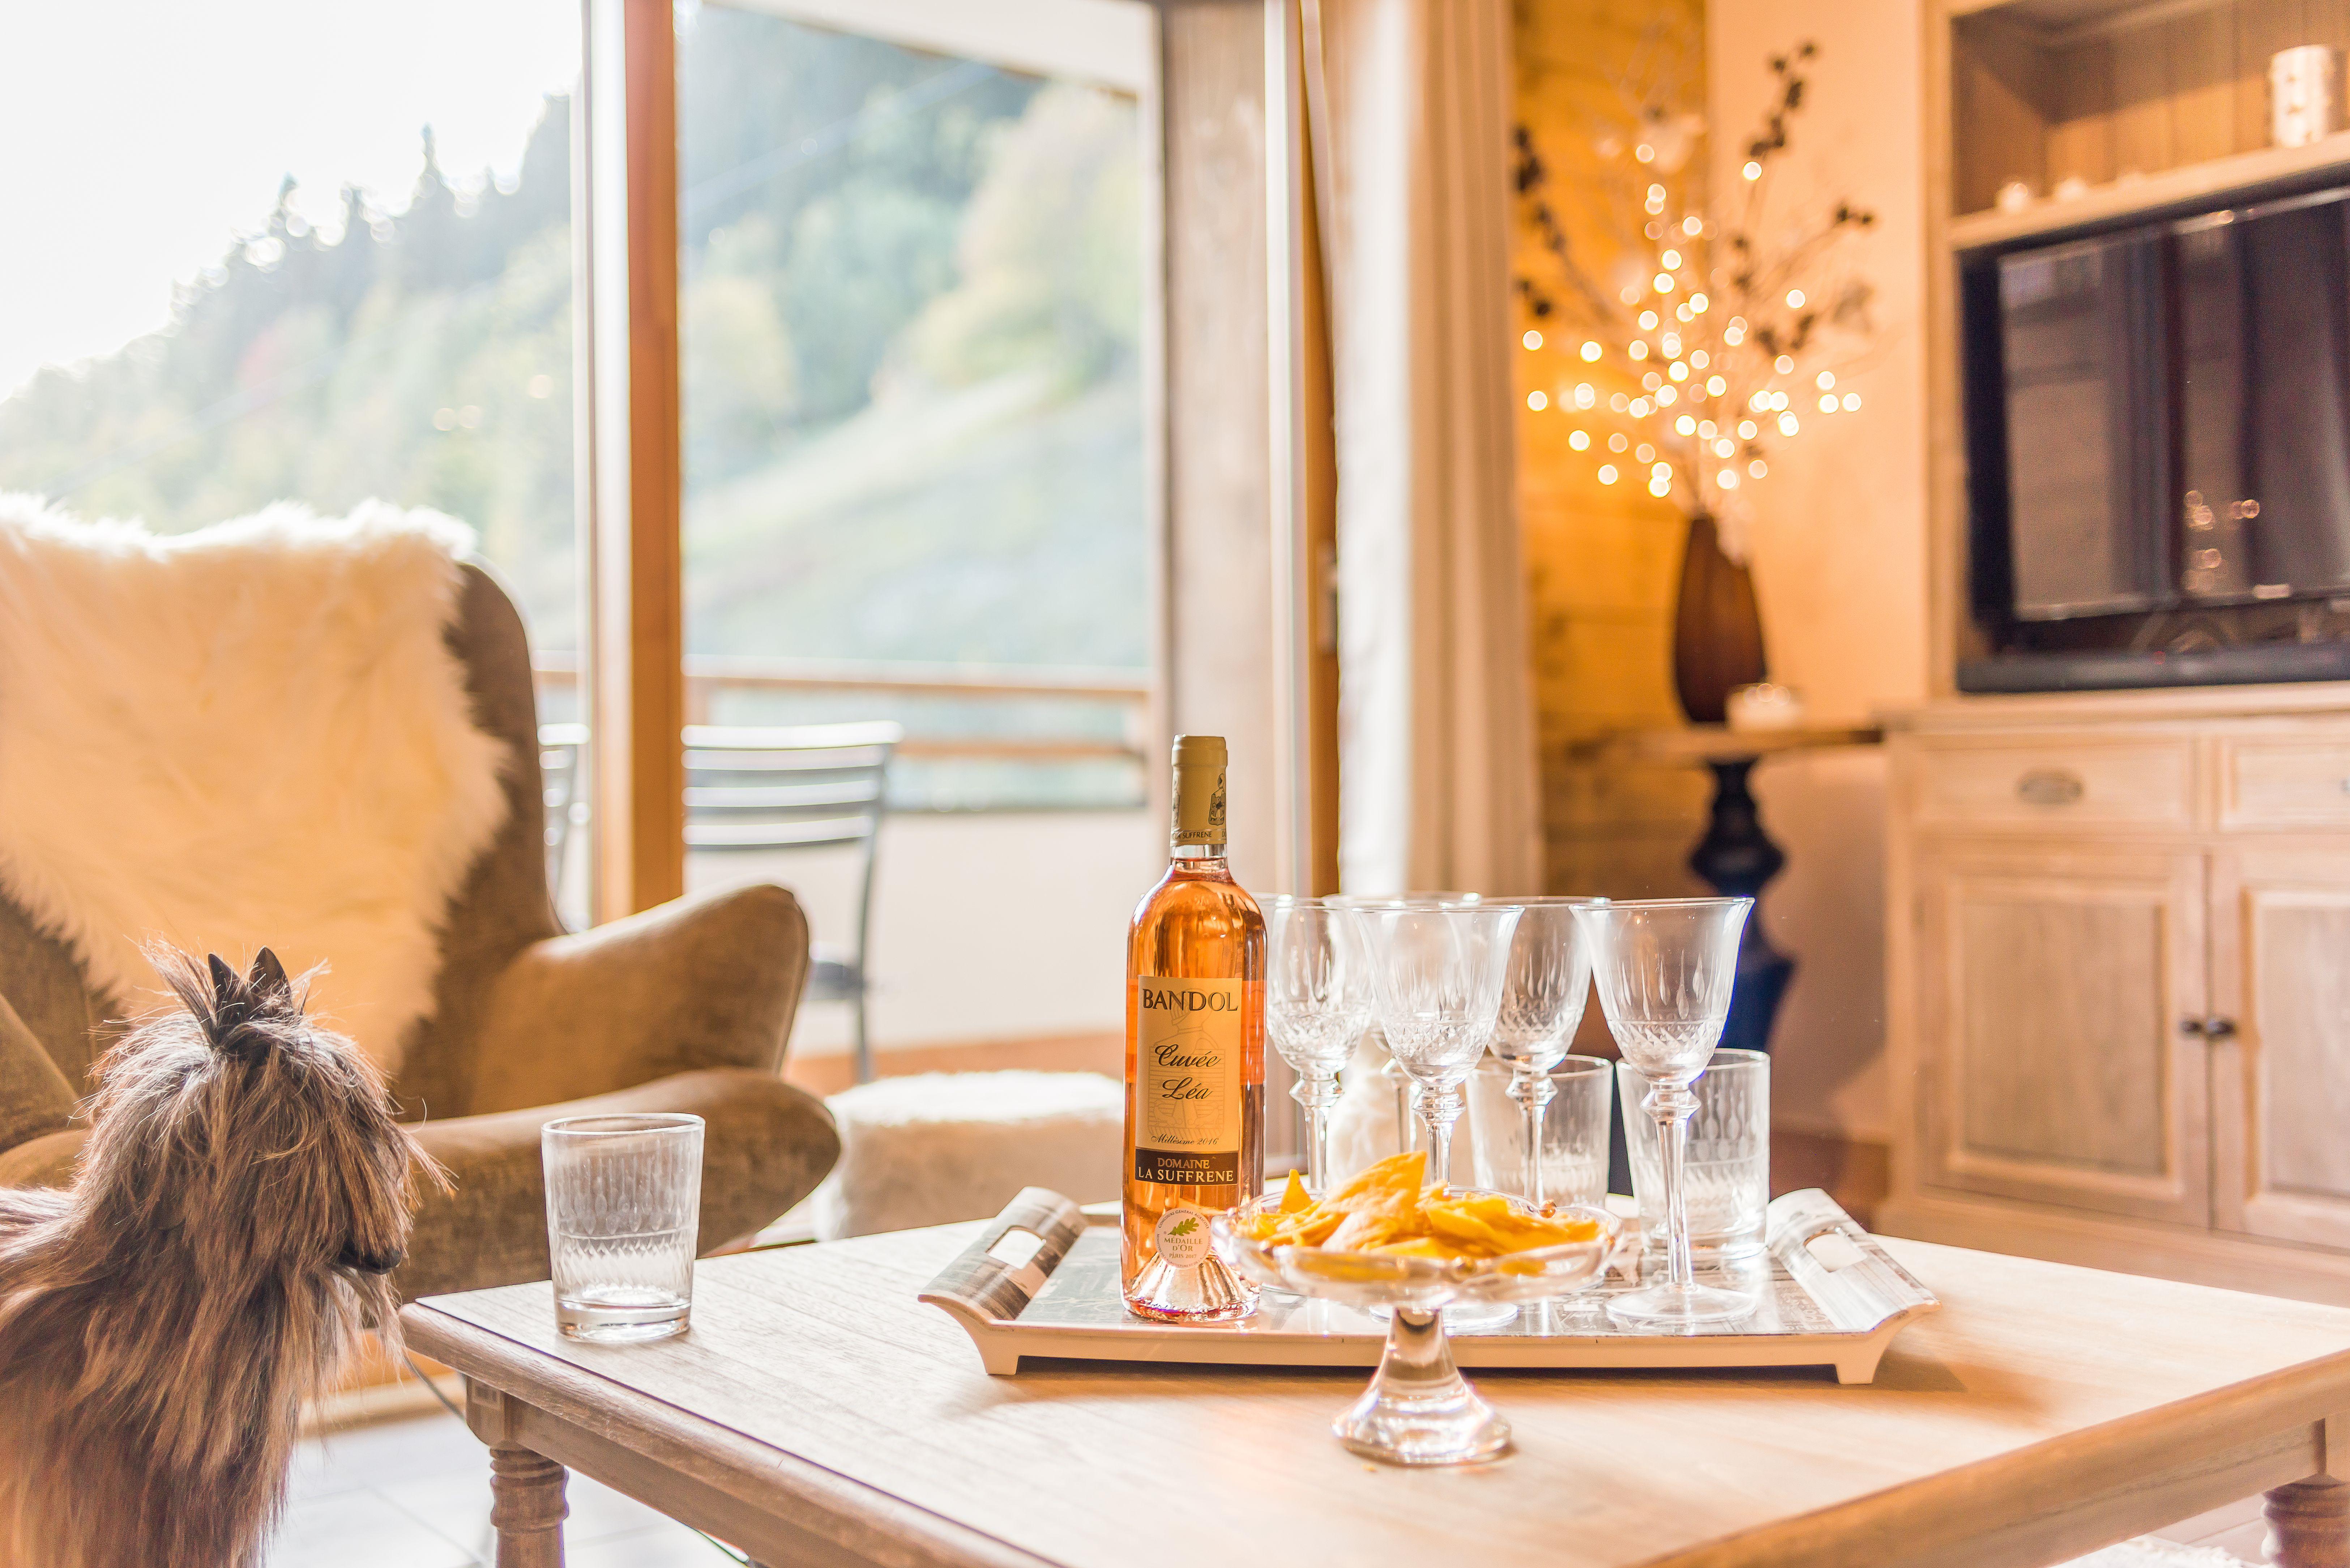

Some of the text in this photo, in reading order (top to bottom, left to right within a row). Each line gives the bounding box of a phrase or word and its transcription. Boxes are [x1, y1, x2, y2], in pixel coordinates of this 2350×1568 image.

[1143, 989, 1238, 1011] BANDOL
[1155, 1044, 1221, 1067] Cuvée
[1162, 1077, 1213, 1100] Léa
[1151, 1133, 1195, 1145] Millésime
[1157, 1158, 1210, 1169] DOMAINE
[1139, 1167, 1233, 1182] LA SUFFRENE
